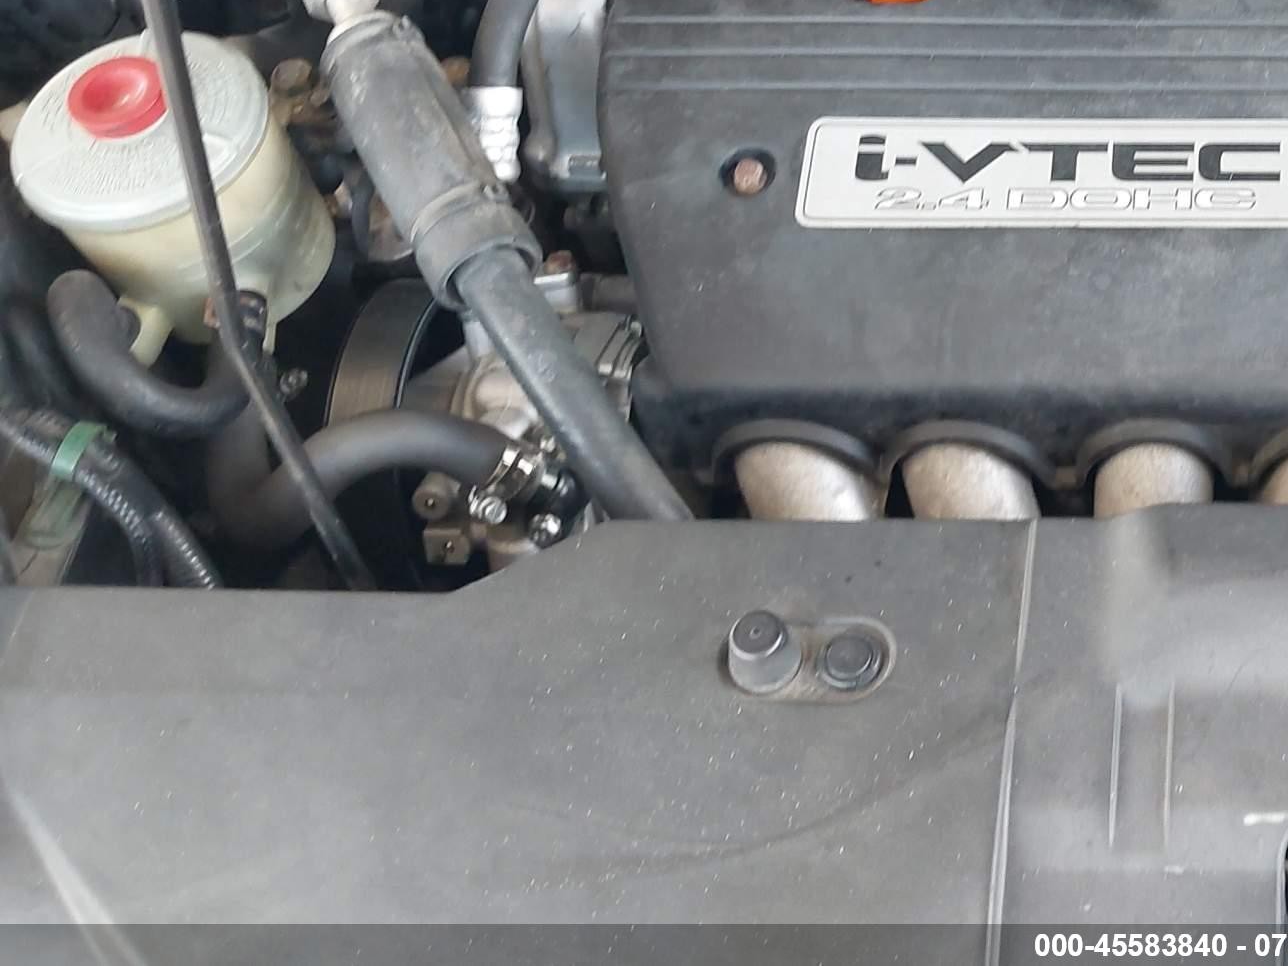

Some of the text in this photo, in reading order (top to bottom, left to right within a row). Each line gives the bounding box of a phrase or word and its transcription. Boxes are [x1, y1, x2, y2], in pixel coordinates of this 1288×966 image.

[855, 134, 1280, 183] i-VTEC
[873, 186, 1256, 211] 2.4 DOHC
